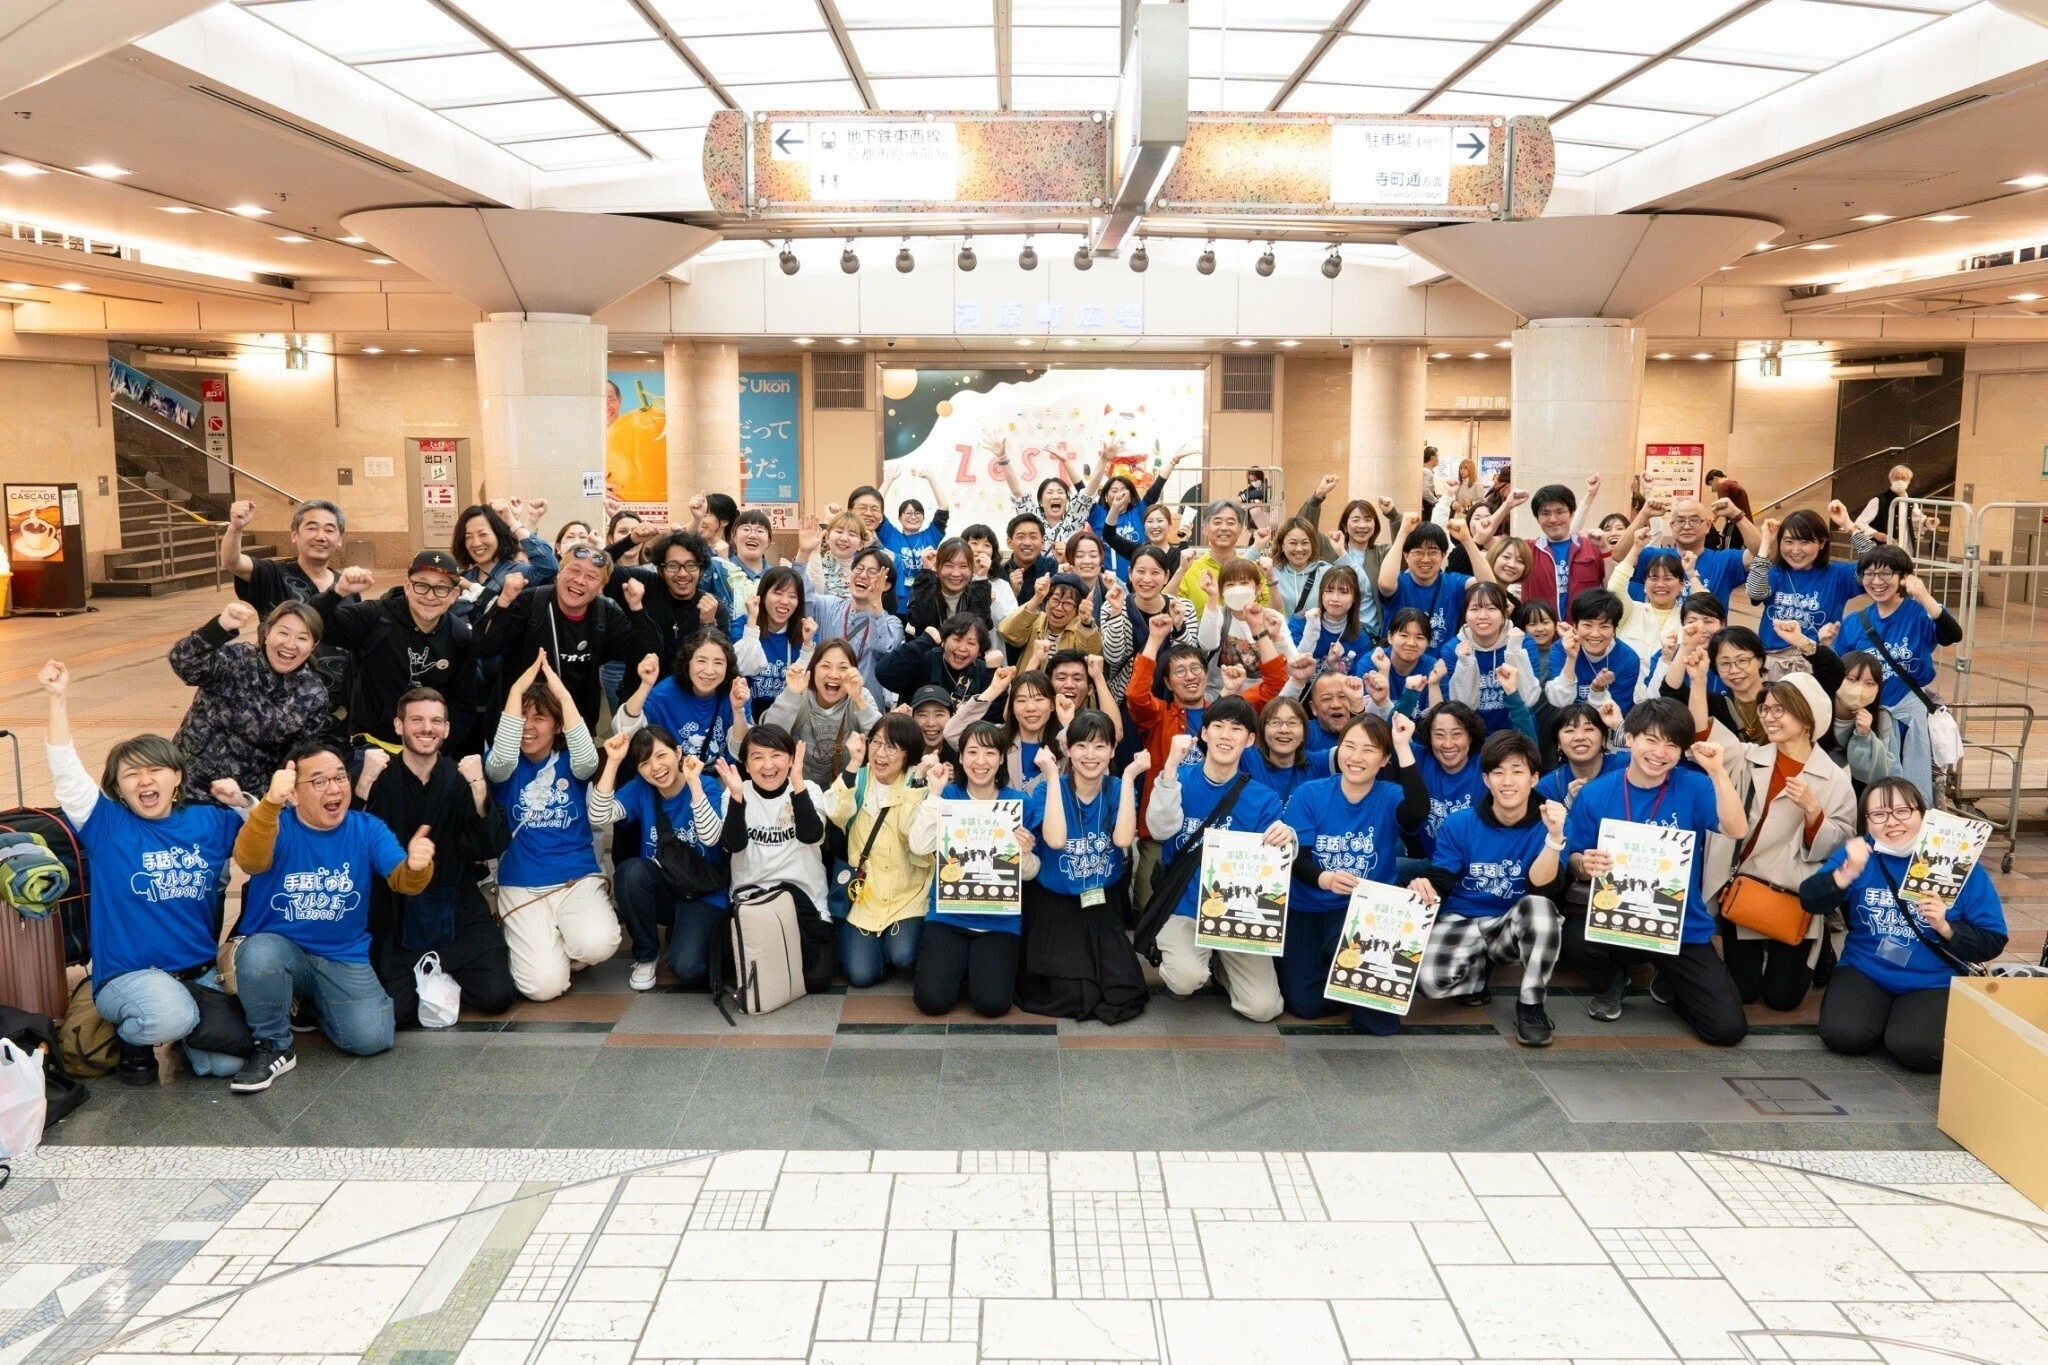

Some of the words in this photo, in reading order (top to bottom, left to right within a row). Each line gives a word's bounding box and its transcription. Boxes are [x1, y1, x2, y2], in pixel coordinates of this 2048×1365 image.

[848, 129, 941, 144] 地下鉄東西線
[751, 379, 791, 393] Ukon
[10, 493, 57, 501] CASCADE
